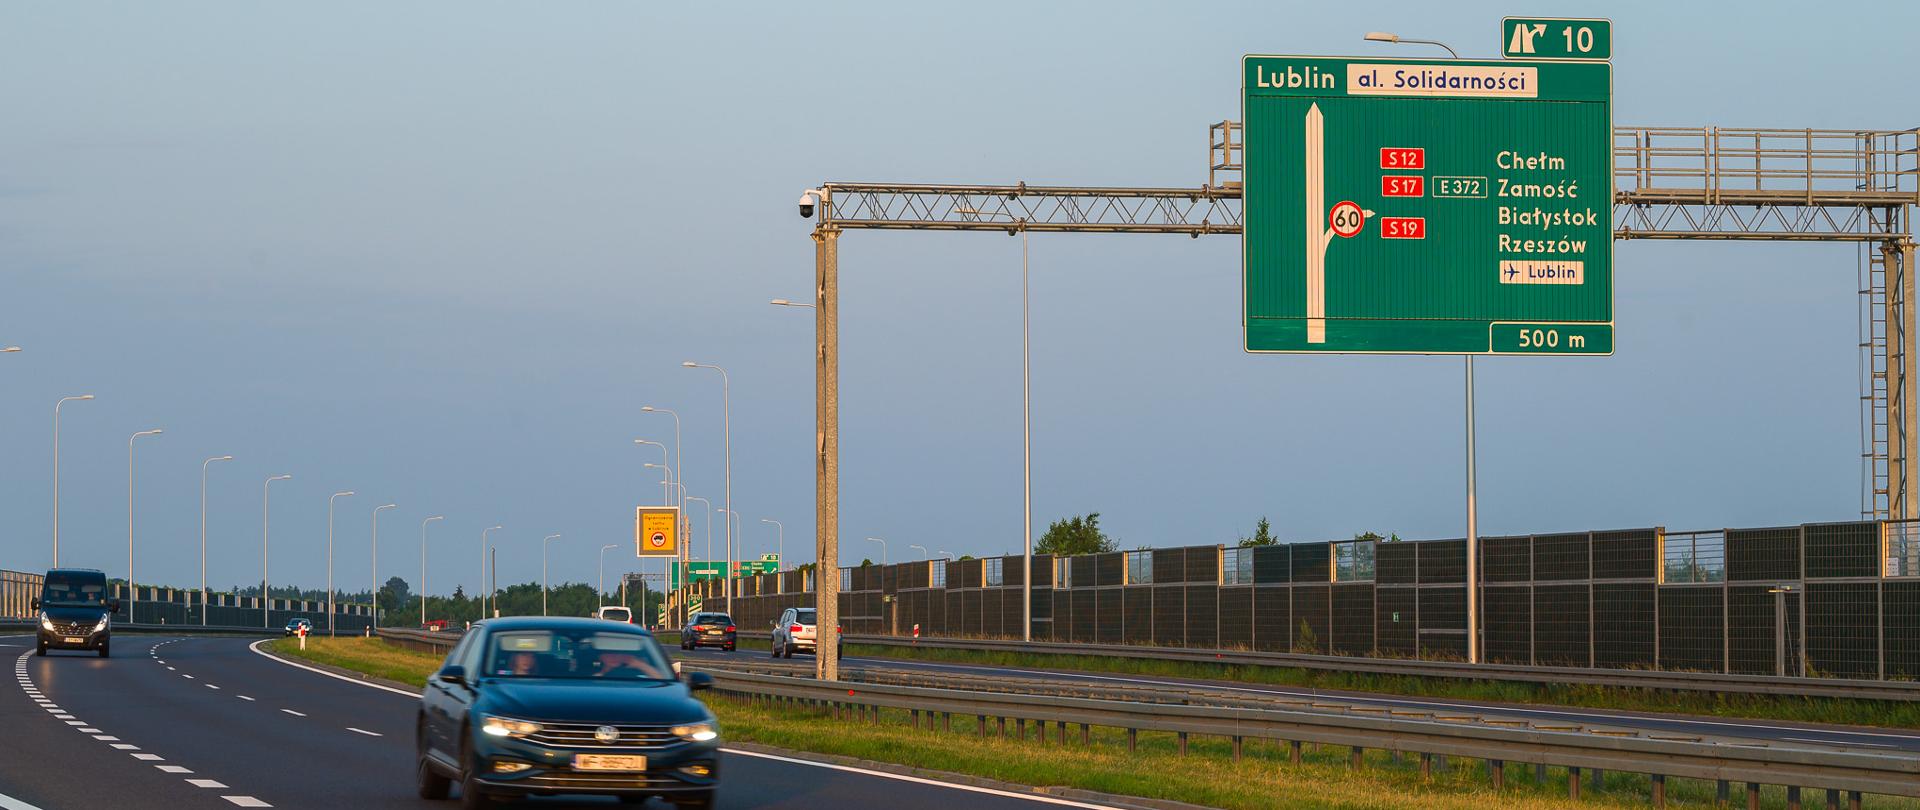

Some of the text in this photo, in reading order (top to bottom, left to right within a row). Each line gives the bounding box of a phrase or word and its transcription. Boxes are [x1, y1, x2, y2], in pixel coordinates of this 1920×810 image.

[1563, 27, 1593, 52] 10
[1257, 65, 1335, 89] Lublin
[1358, 69, 1526, 91] al. Solidarności
[1496, 151, 1565, 170] Chełm
[1497, 179, 1578, 199] Zamość
[1334, 209, 1359, 228] 60
[1498, 206, 1597, 231] Białystok
[1498, 234, 1587, 255] Rzeszów
[1528, 264, 1576, 279] Lublin
[1519, 329, 1585, 348] 500 m
